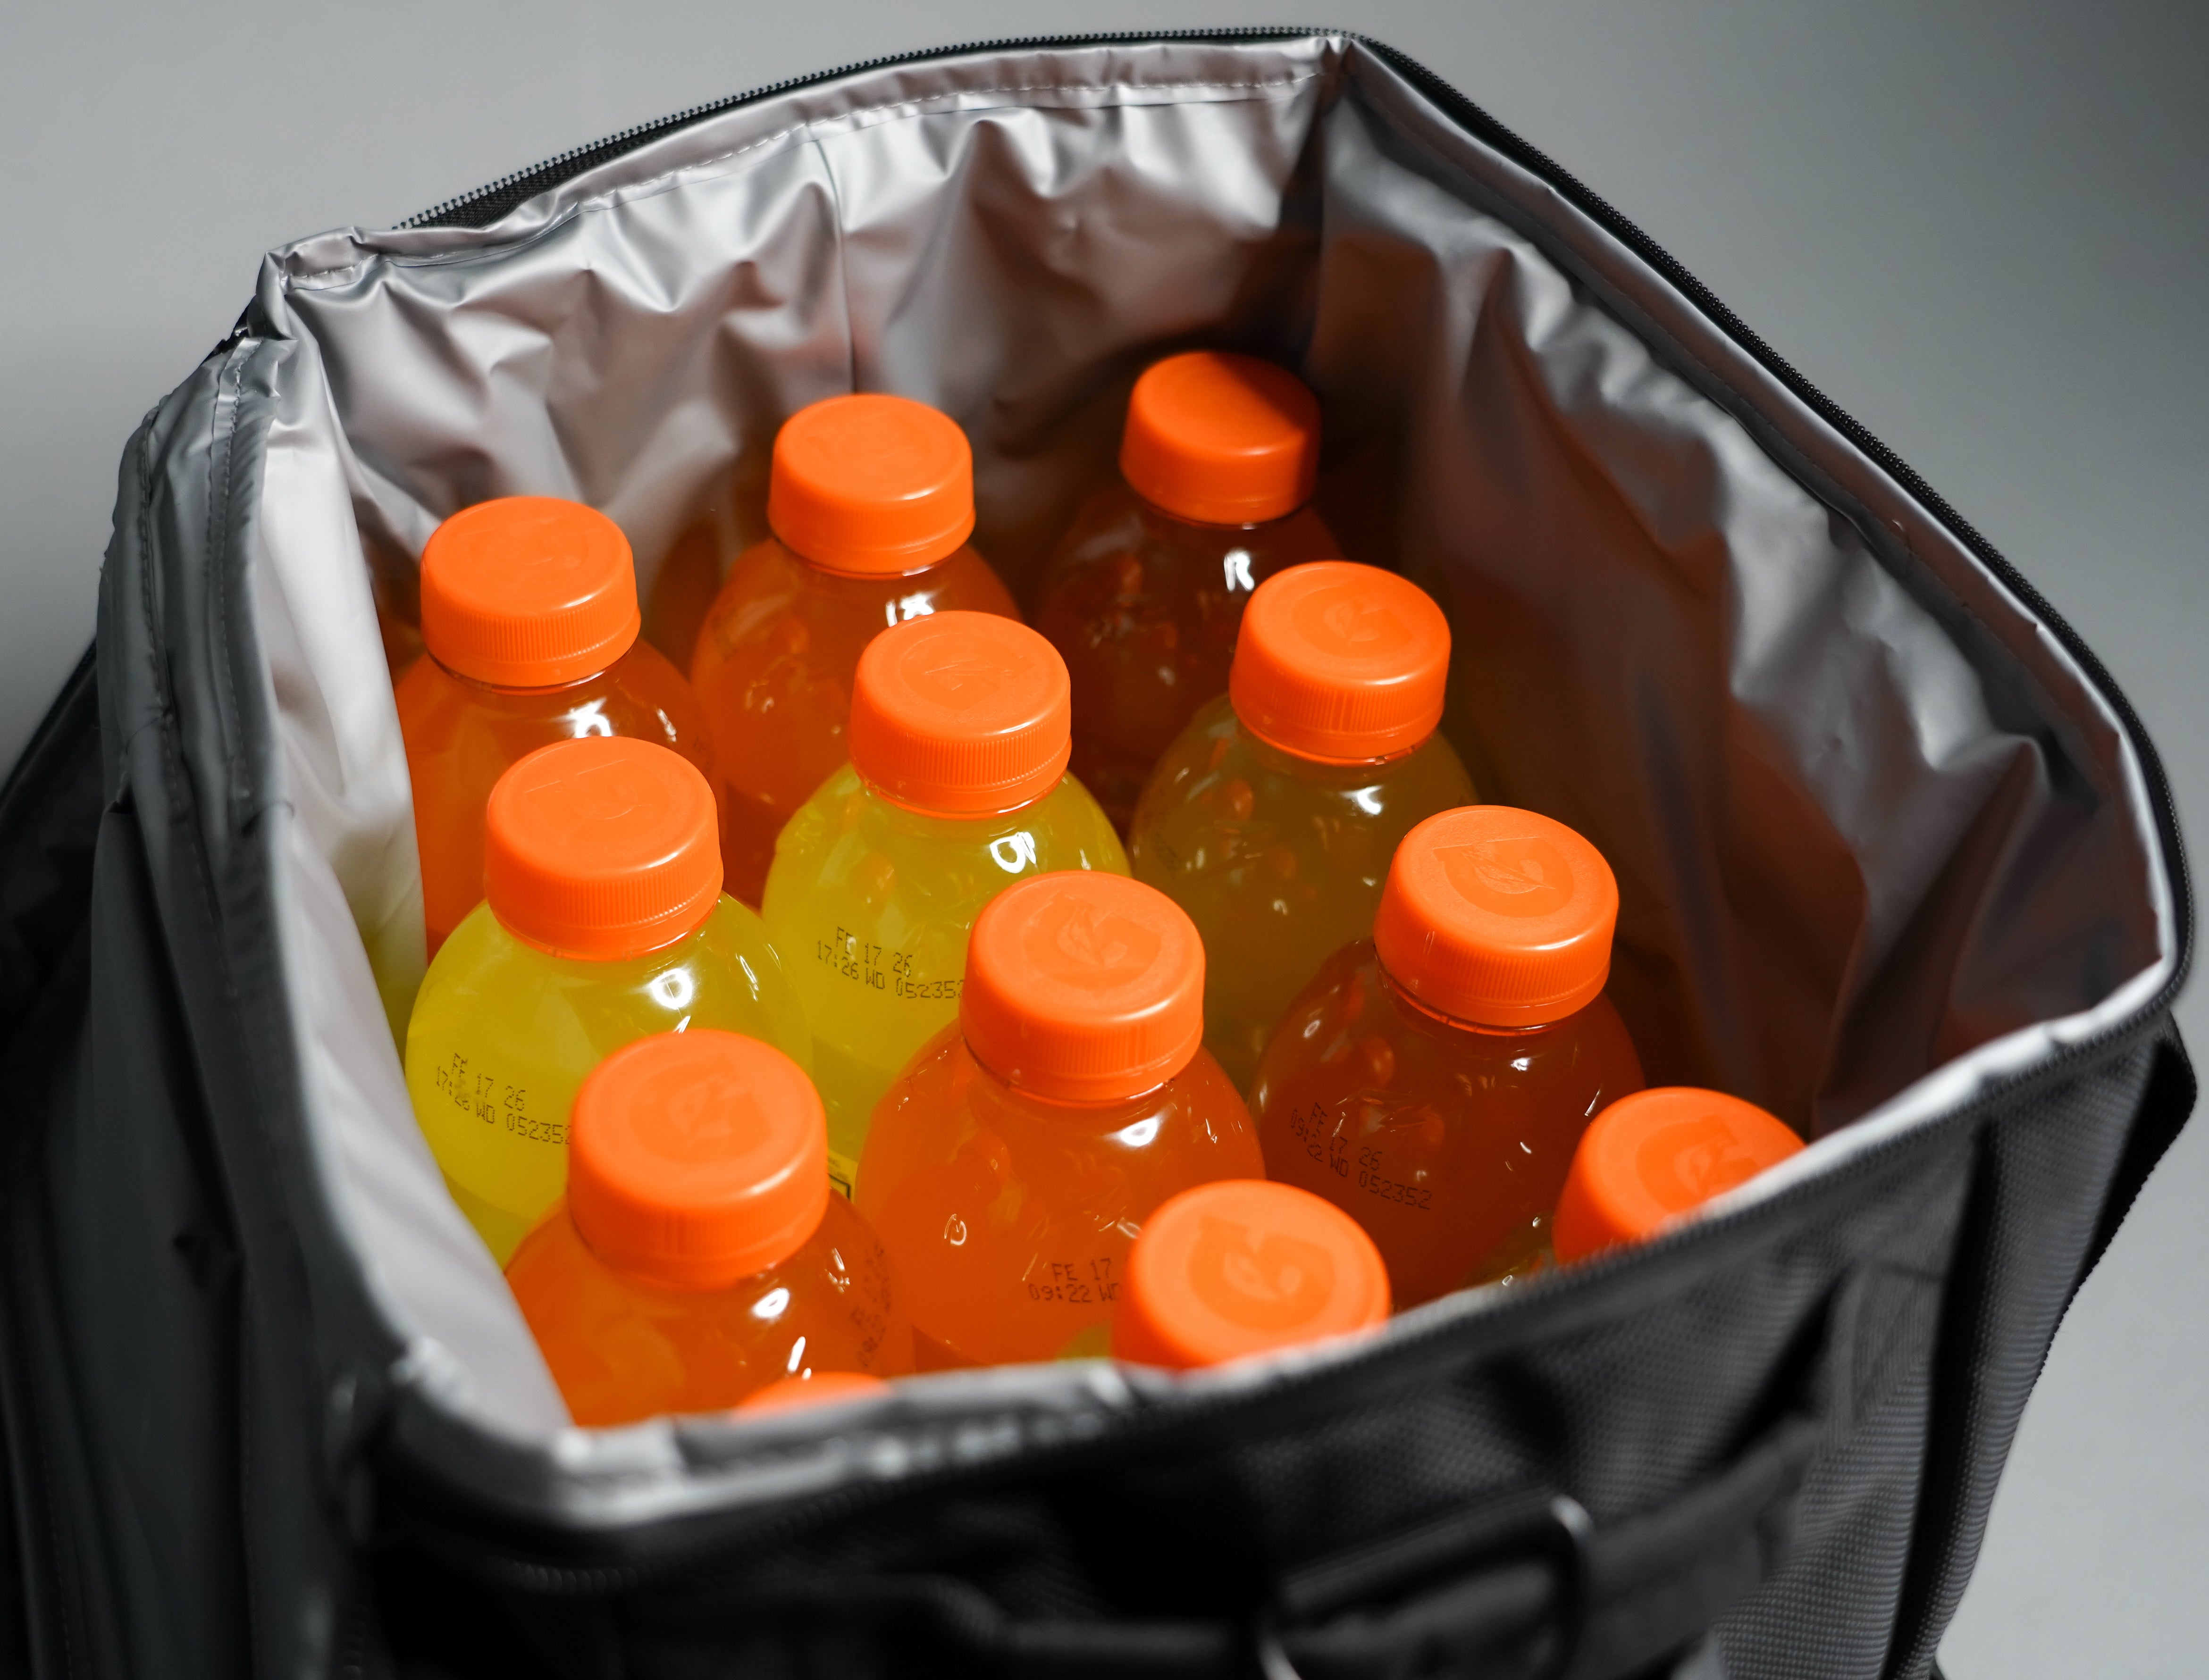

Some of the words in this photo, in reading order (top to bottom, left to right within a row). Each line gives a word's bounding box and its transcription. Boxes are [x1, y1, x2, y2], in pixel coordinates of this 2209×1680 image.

[818, 940, 859, 980] 17:26
[866, 968, 885, 990] WD
[865, 943, 882, 966] 17
[893, 953, 912, 978] 26
[476, 1073, 494, 1098] 17
[504, 1086, 526, 1111] 26
[476, 1101, 495, 1124] WD
[1359, 1147, 1383, 1171] 26
[1329, 1153, 1349, 1178] WD
[1359, 1170, 1432, 1210] 052352
[1051, 1262, 1078, 1282] FE
[1090, 1257, 1110, 1280] 17
[1028, 1283, 1093, 1303] 09:22
